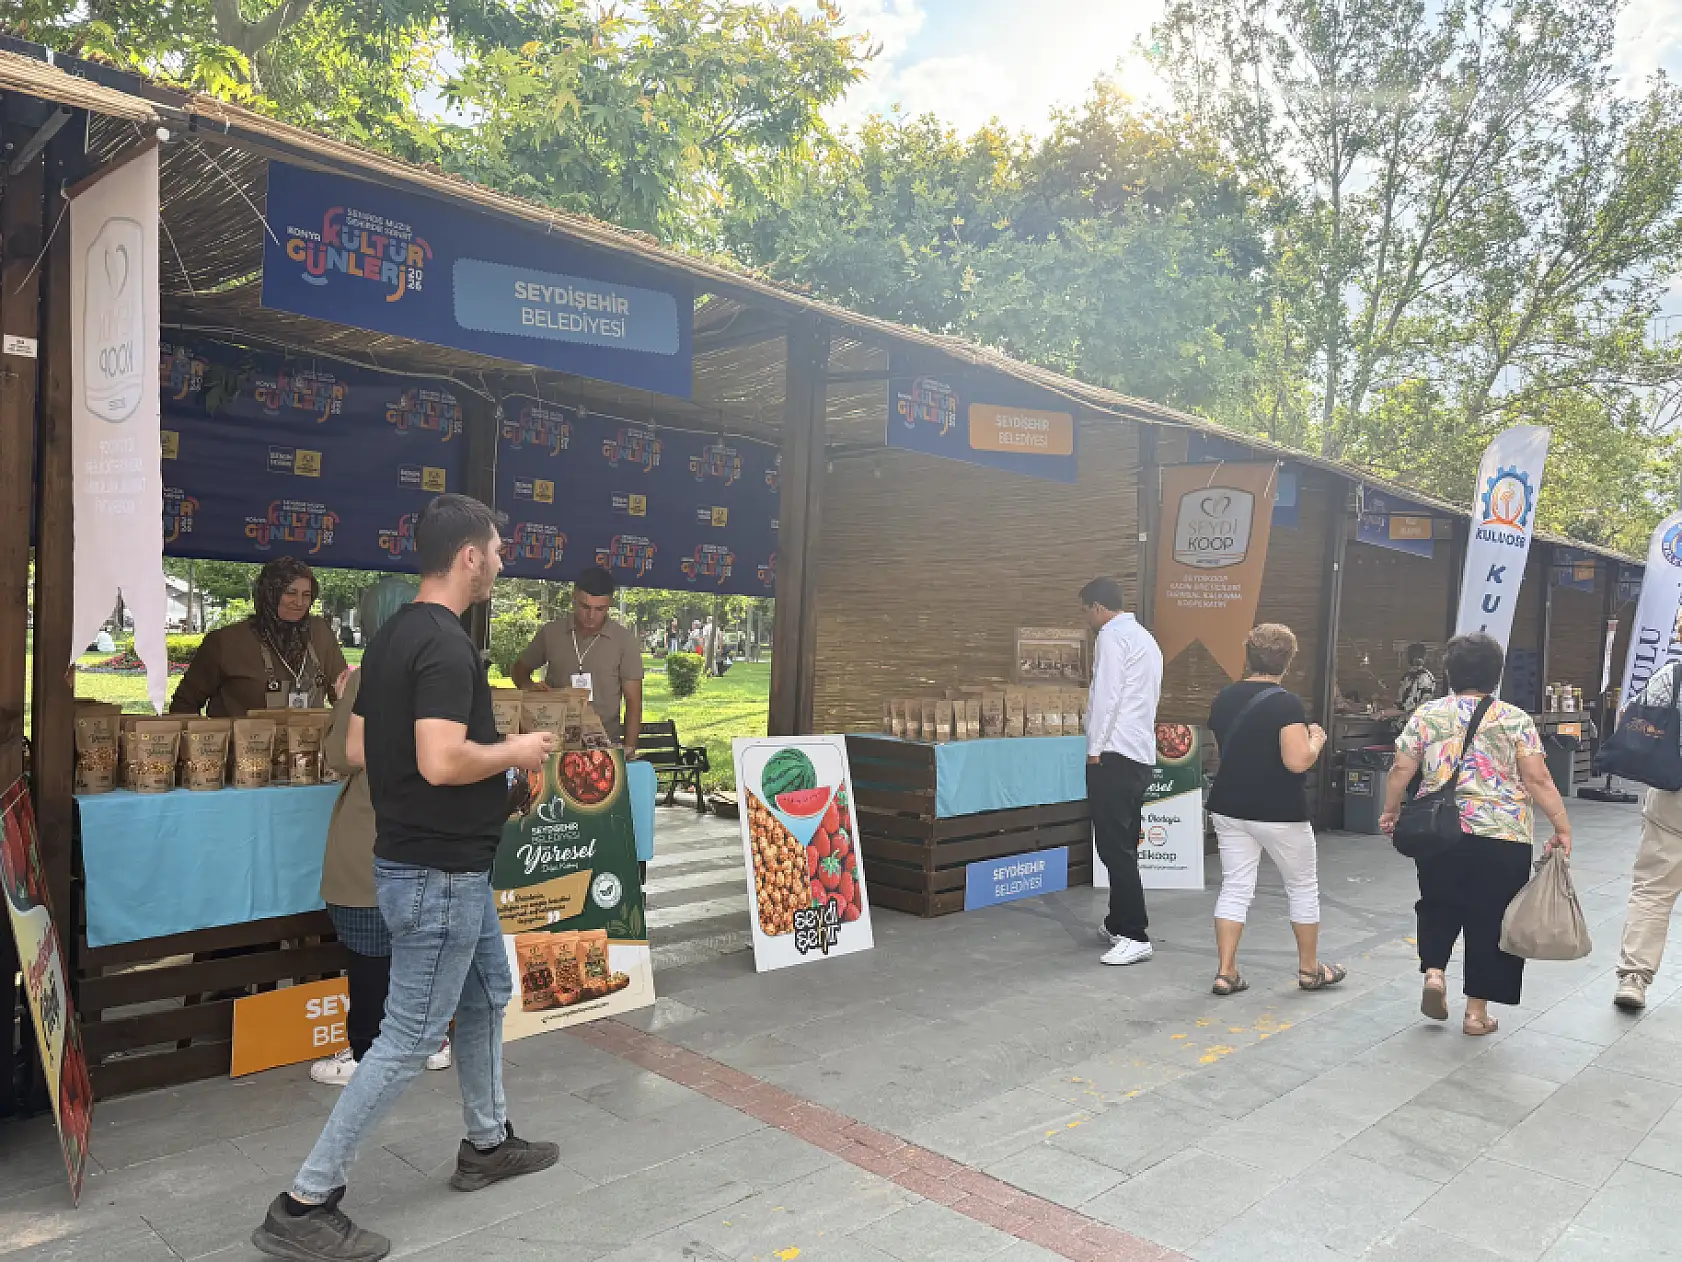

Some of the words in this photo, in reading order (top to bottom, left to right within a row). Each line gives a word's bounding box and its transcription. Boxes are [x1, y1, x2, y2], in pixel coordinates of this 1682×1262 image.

[287, 225, 321, 241] KONYA
[322, 206, 424, 268] KÜLTÜR
[514, 281, 629, 315] SEYDİŞEHİR
[522, 307, 626, 339] BELEDİYESİ
[995, 414, 1050, 431] SEYDİŞEHİR
[999, 431, 1048, 447] BELEDİYESİ
[1188, 518, 1238, 535] SEYDİ
[1188, 536, 1234, 551] KOOP
[516, 838, 597, 875] Yöresel
[992, 860, 1047, 880] SEYDİŞEHİR
[995, 875, 1043, 898] BELEDİYESİ
